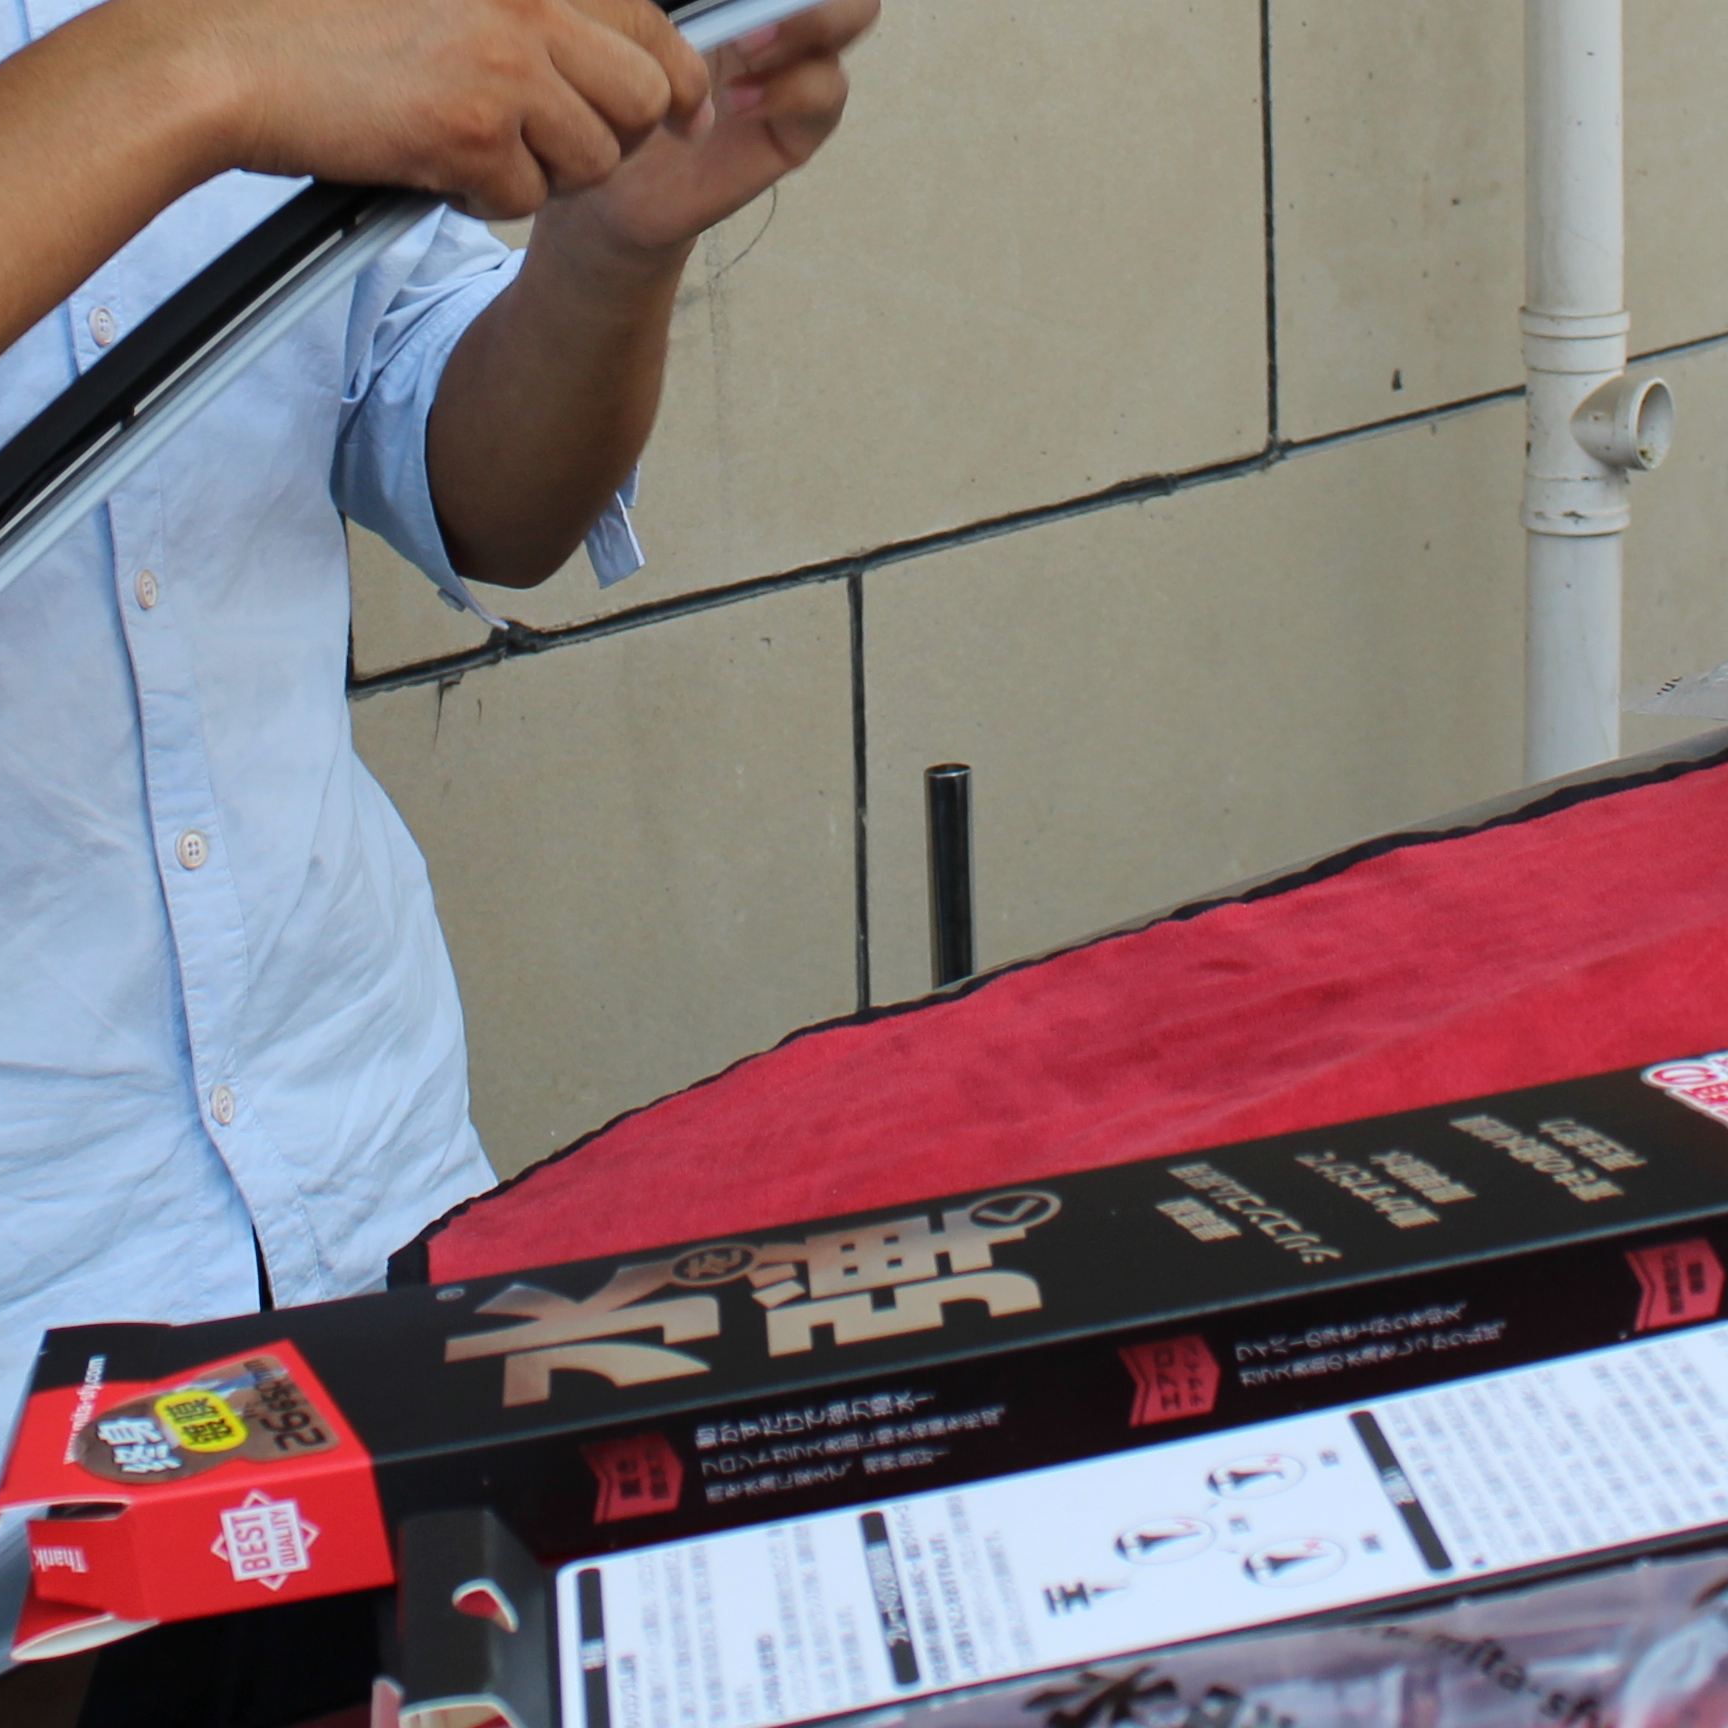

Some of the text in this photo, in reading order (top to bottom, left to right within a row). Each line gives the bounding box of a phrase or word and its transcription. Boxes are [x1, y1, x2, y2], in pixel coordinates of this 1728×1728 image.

[96, 1415, 183, 1474] 终身
[32, 1545, 90, 1573] Thank
[230, 1514, 273, 1573] BEST
[270, 1508, 301, 1569] QUALITY
